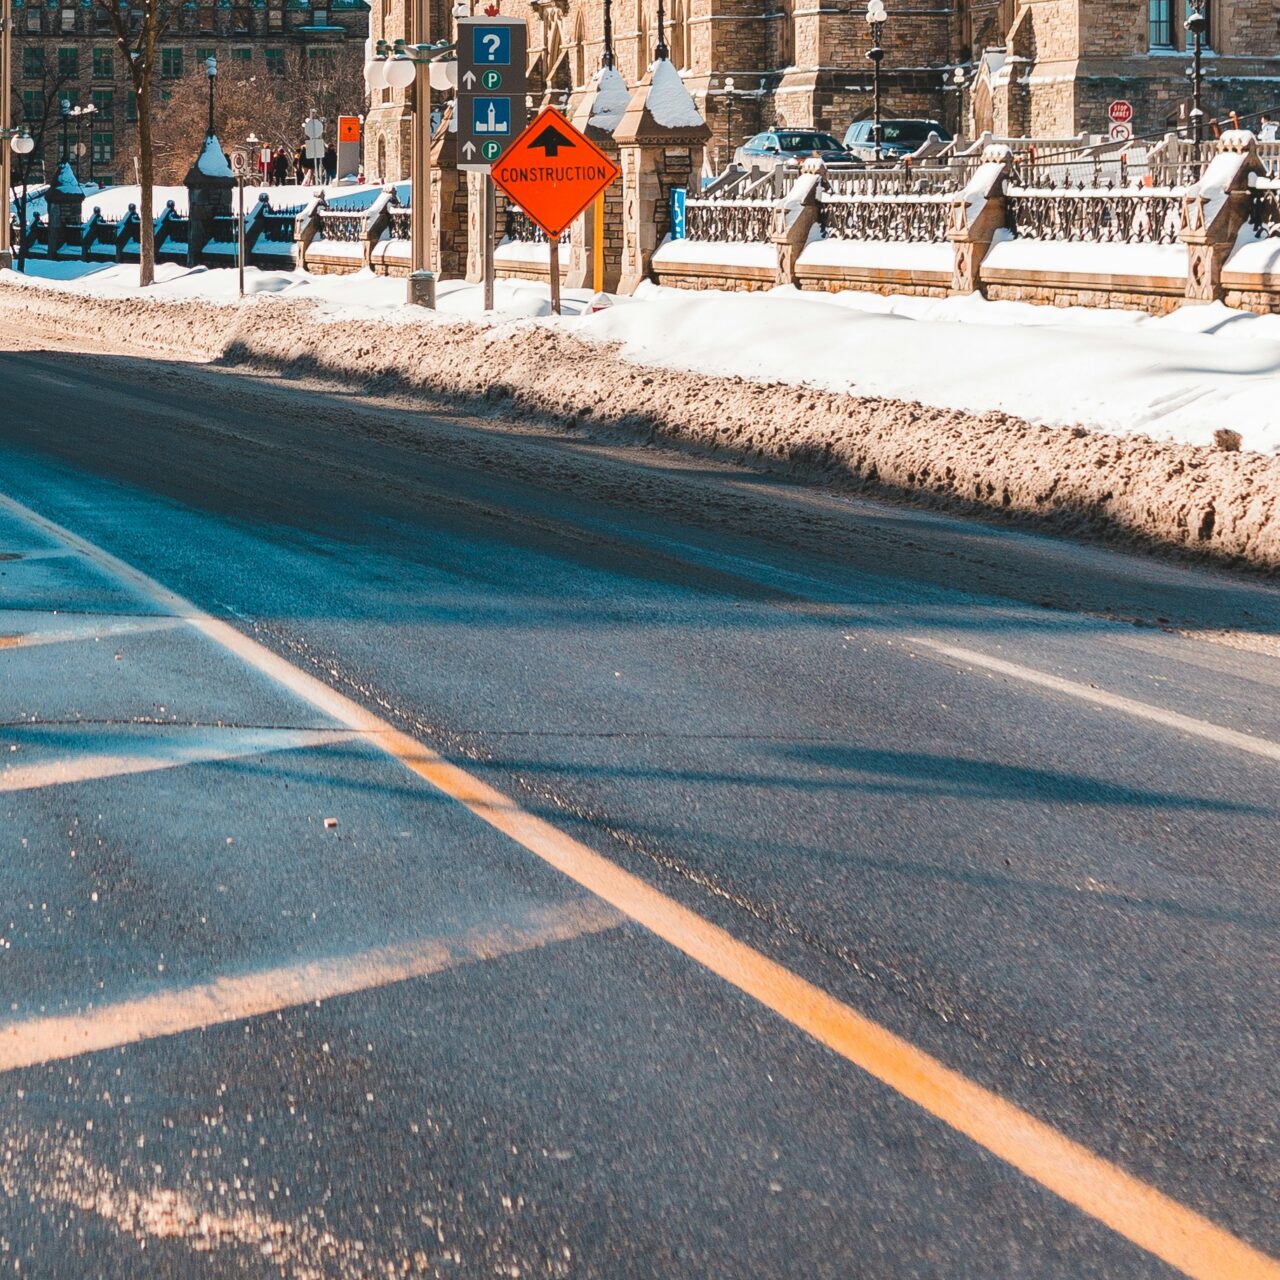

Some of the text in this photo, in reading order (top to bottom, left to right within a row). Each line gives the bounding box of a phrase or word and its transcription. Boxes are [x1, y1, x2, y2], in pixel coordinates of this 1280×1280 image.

[488, 73, 497, 87] P
[488, 144, 497, 158] P
[501, 166, 606, 182] CONSTRUCTION
